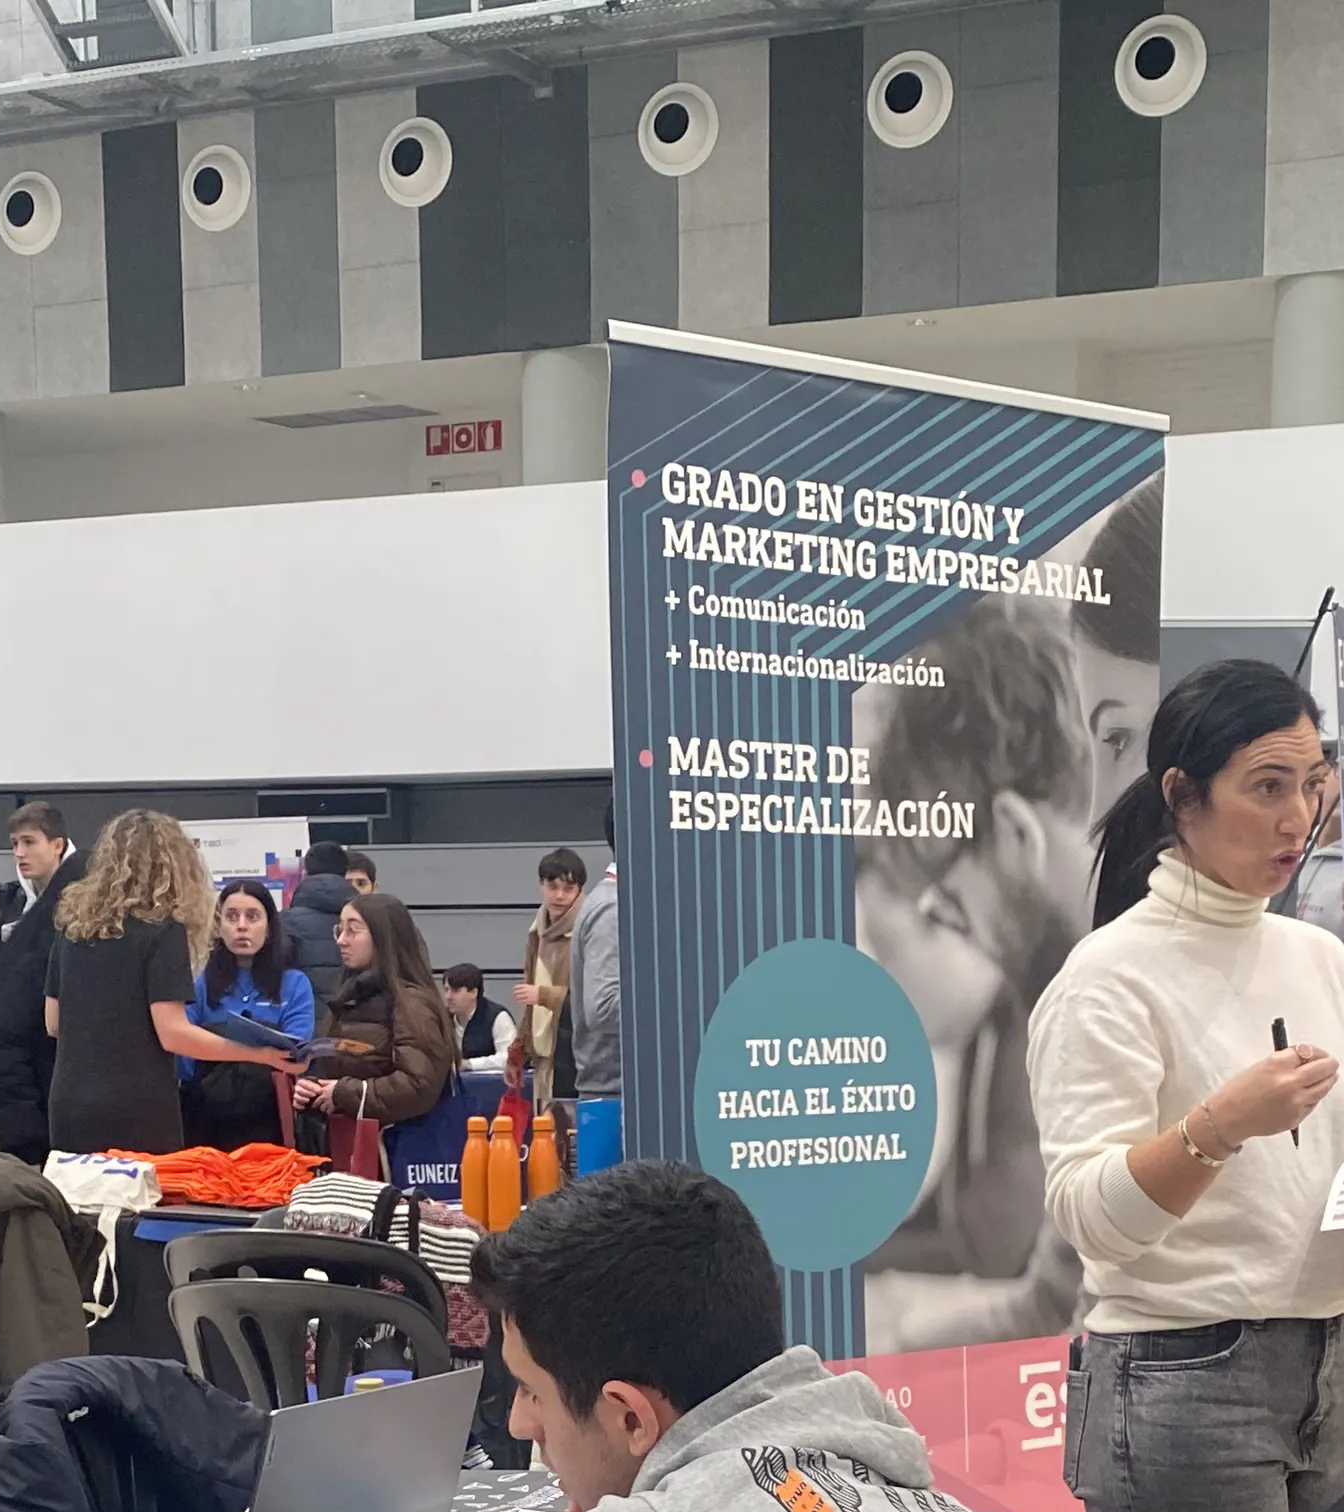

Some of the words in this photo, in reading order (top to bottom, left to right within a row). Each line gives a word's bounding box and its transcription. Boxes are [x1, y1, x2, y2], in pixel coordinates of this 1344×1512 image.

[662, 462, 787, 516] GRADO
[796, 479, 844, 523] EN
[854, 490, 995, 541] GESTIÓN
[1002, 506, 1025, 544] Y
[662, 517, 877, 580] MARKETING
[885, 543, 1111, 605] EMPRESARIAL
[688, 584, 867, 630] Comunicación
[688, 639, 946, 687] Internacionalización
[667, 736, 818, 784] MASTER
[827, 746, 871, 785] DE
[669, 790, 975, 838] ESPECIALIZACIÓN
[745, 1038, 781, 1067] TU
[787, 1036, 887, 1066] CAMINO
[718, 1089, 799, 1119] HACIA
[804, 1087, 836, 1116] EL
[842, 1079, 916, 1114] ÉXITO
[407, 1163, 458, 1185] EUNEIZ
[730, 1133, 907, 1170] PROFESIONAL
